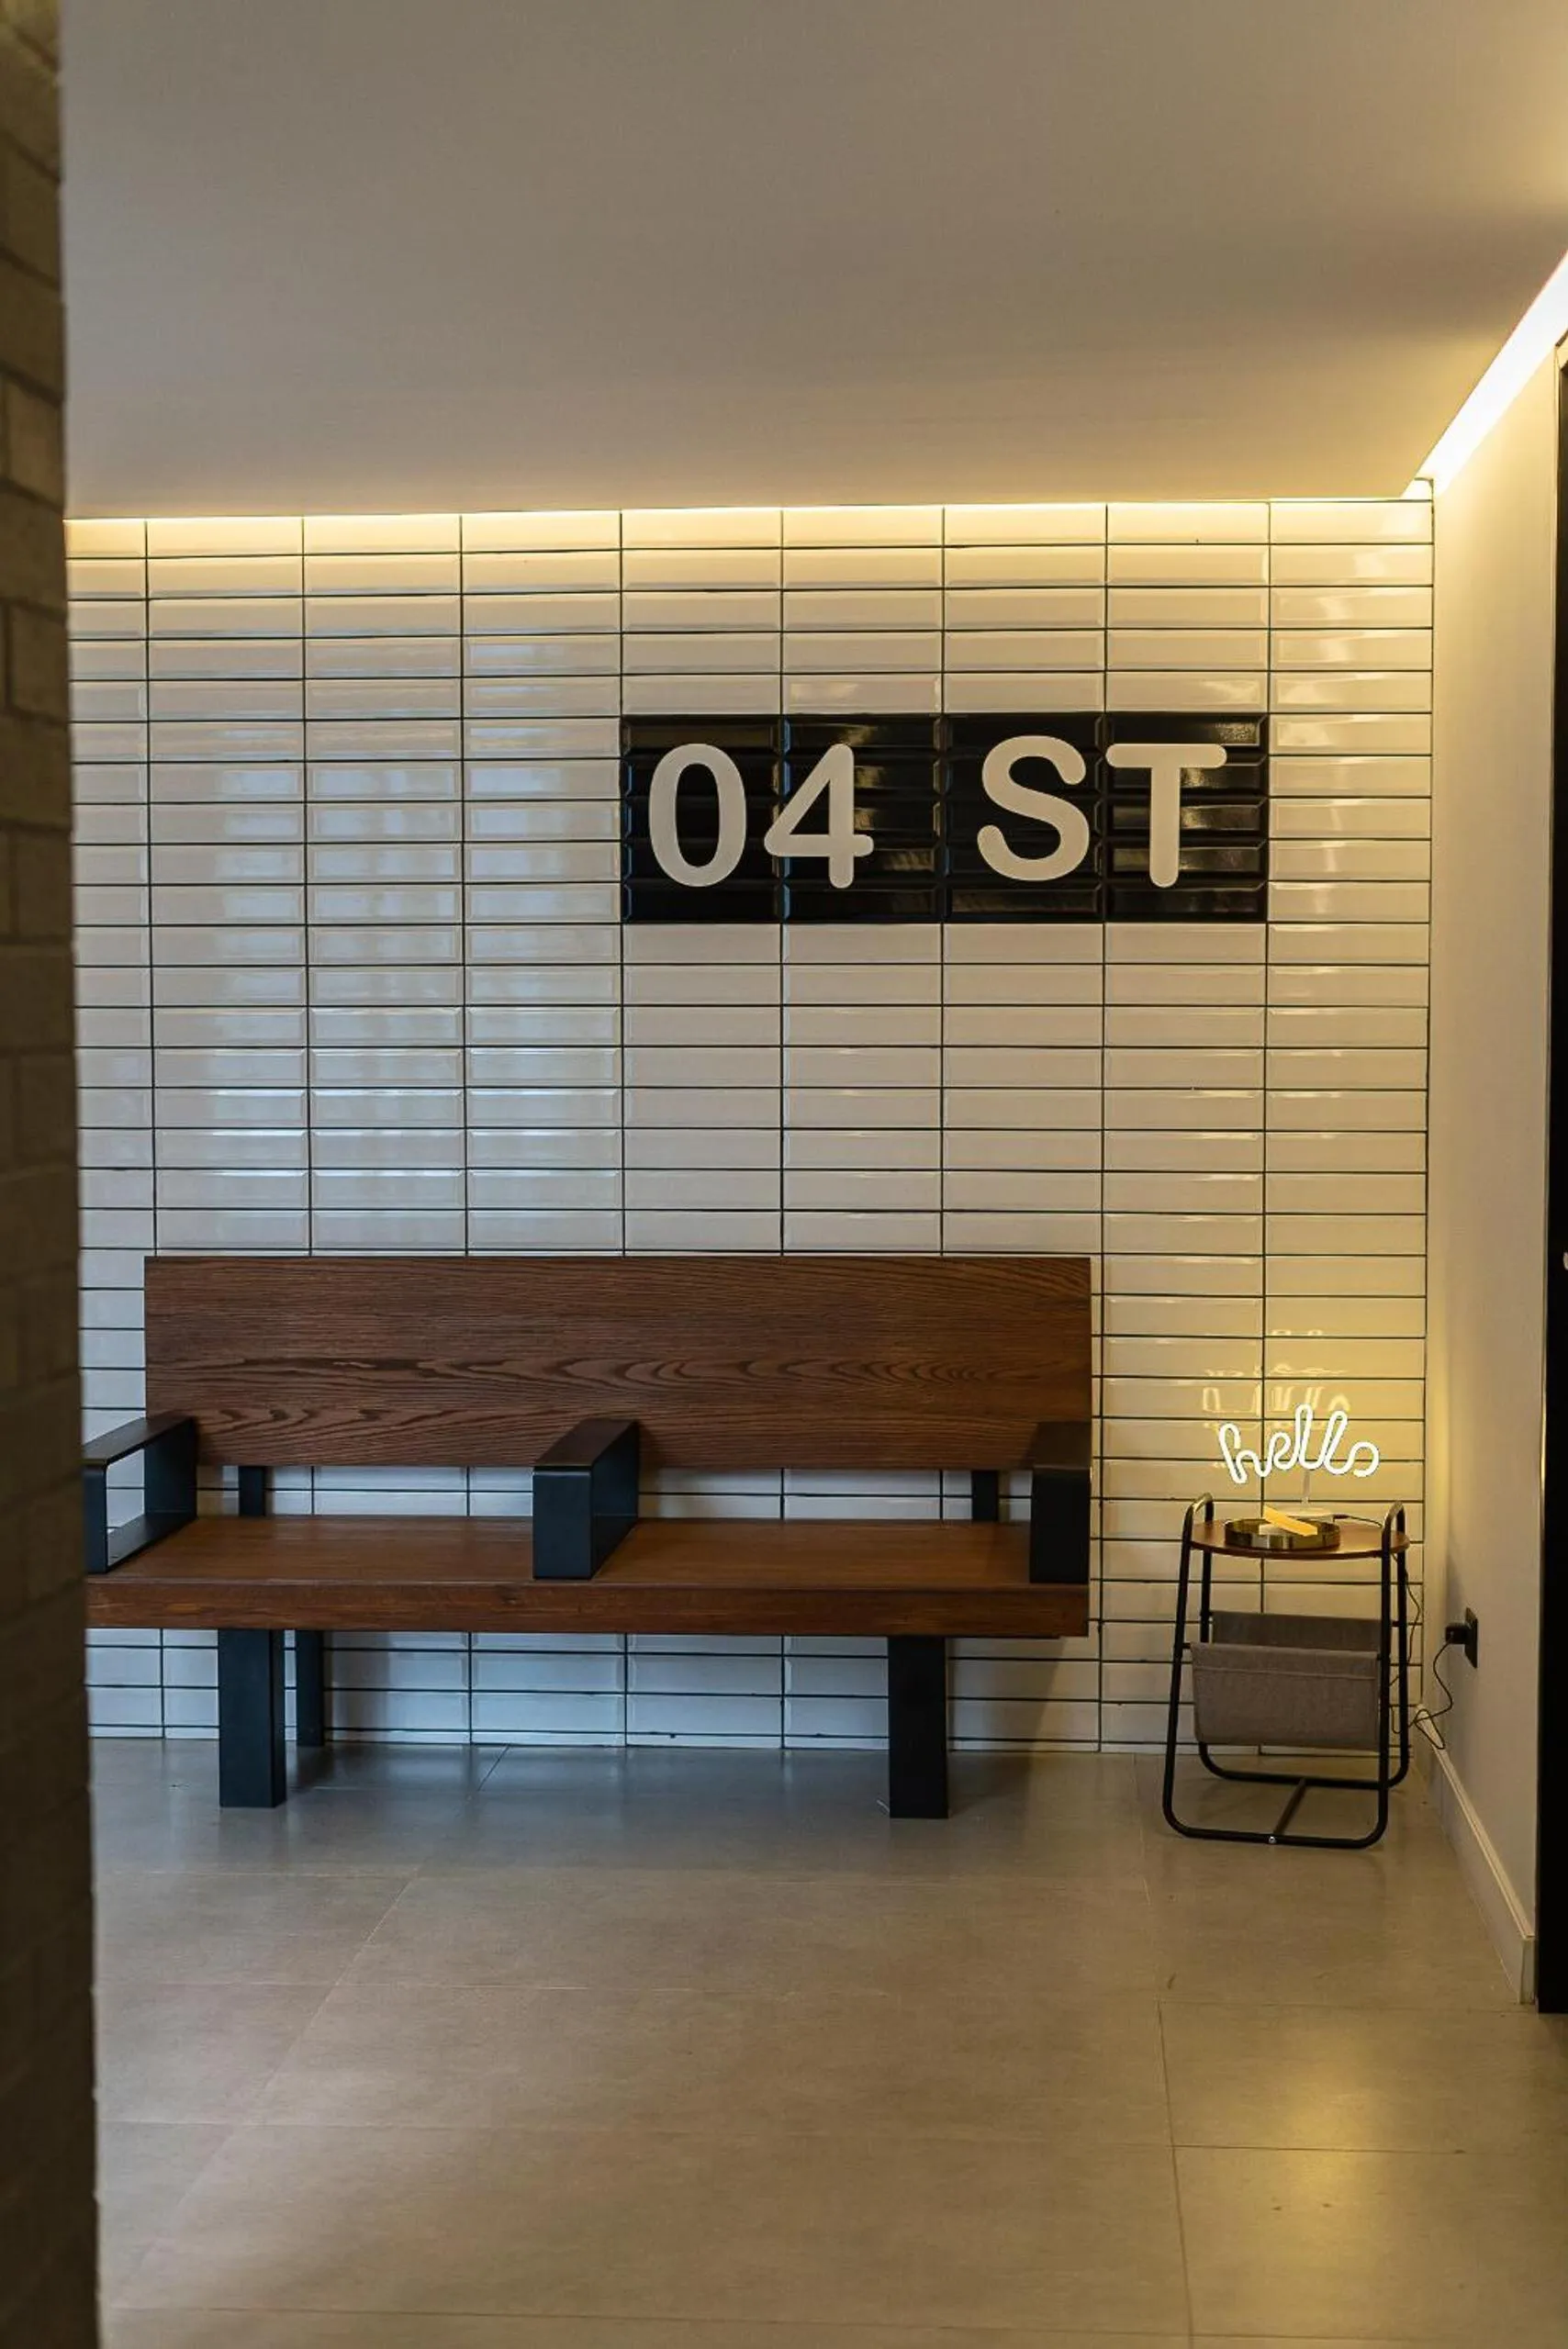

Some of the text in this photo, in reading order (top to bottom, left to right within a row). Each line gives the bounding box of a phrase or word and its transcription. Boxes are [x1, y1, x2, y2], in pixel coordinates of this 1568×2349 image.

[648, 735, 1227, 889] 04 ST
[1218, 1403, 1379, 1484] hello
